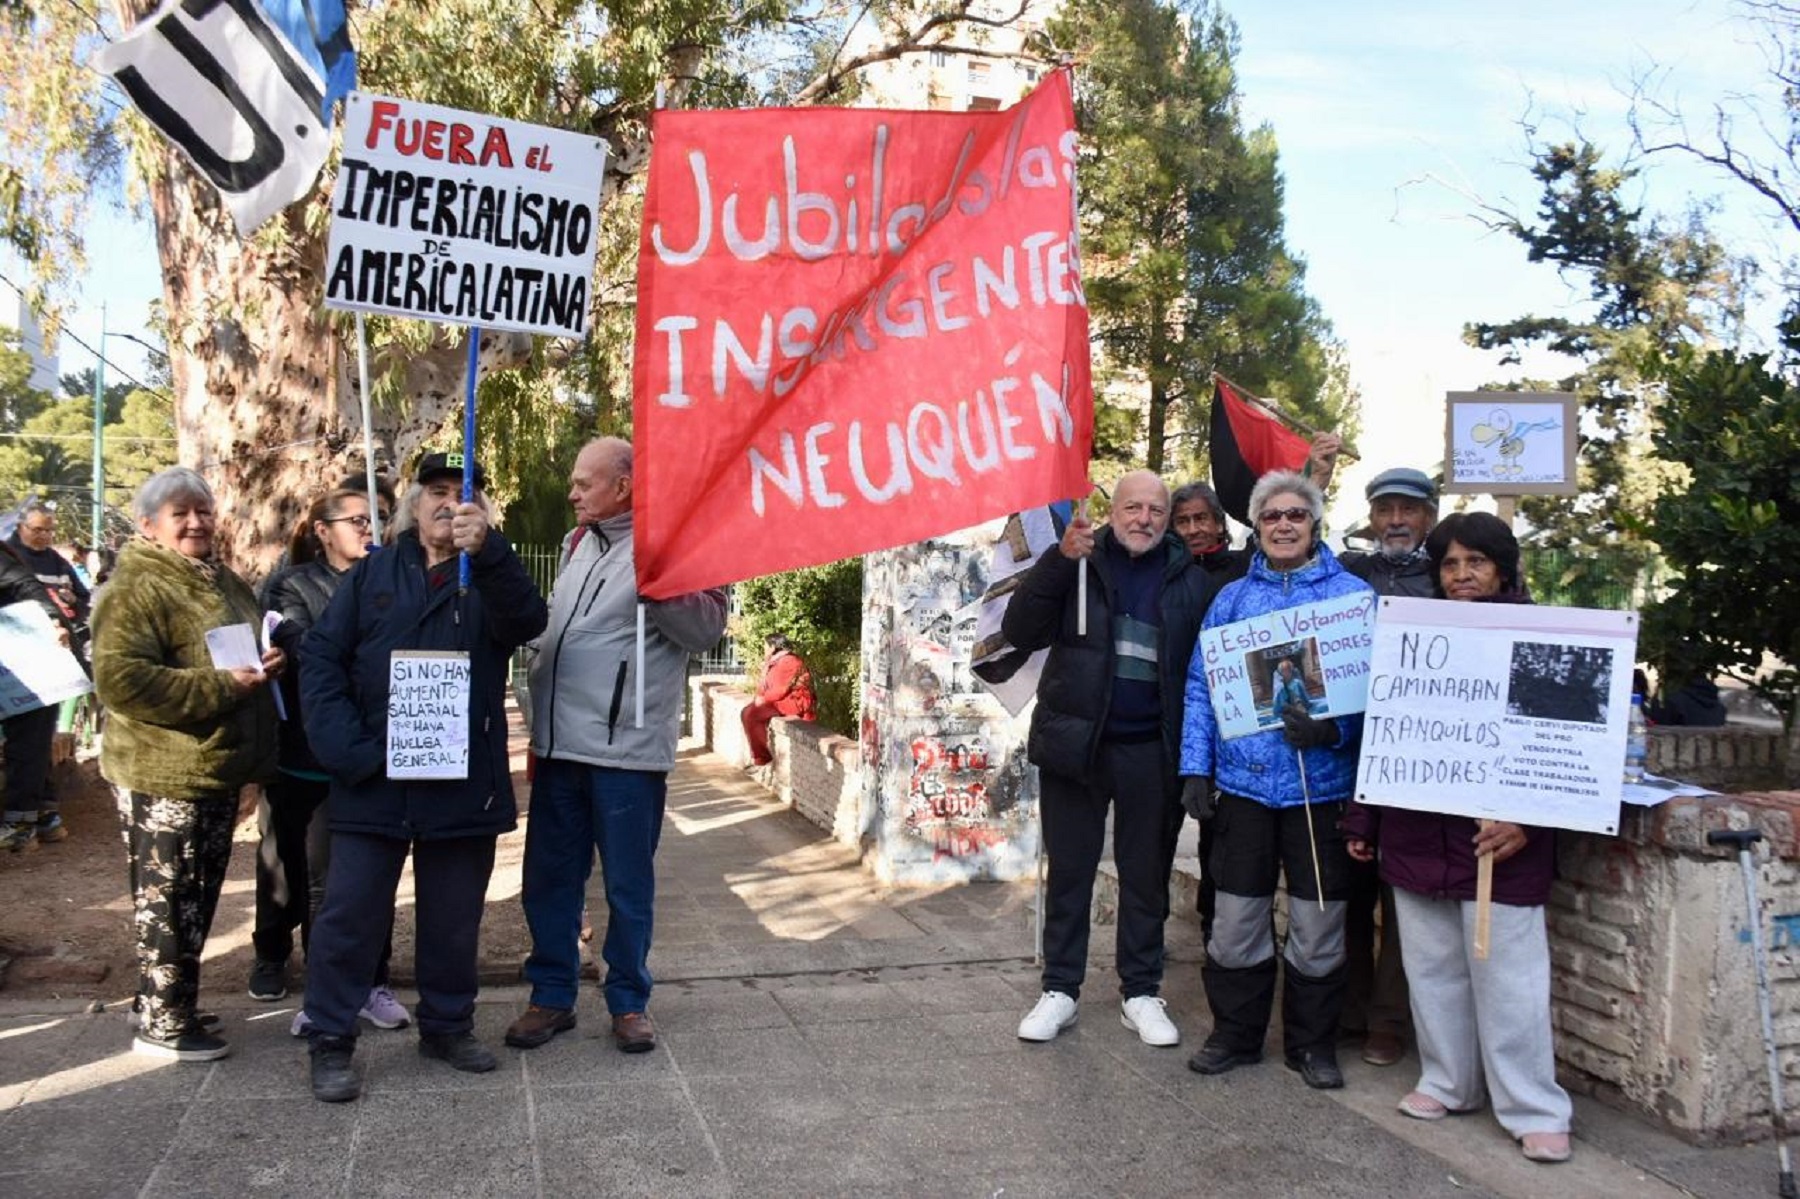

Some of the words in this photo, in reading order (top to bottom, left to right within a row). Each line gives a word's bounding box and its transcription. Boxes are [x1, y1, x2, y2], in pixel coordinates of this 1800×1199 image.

[365, 100, 514, 169] FUERA
[420, 239, 451, 257] DE
[749, 341, 1073, 517] NEUQUÉN
[1206, 624, 1272, 665] ¿Esto
[1281, 596, 1374, 639] Votamos?
[1320, 633, 1372, 657] DORES
[1400, 631, 1451, 671] NO
[418, 661, 443, 680] NO
[444, 661, 471, 682] HAY
[389, 682, 460, 702] AUMENTO
[1223, 689, 1234, 703] A
[1371, 673, 1501, 703] CAMINARAN
[1223, 704, 1243, 721] LA
[413, 720, 446, 734] HAYA
[1502, 717, 1532, 726] PABLO
[1533, 720, 1561, 729] CERVI
[1562, 723, 1608, 734] DIPUTADO
[391, 736, 443, 751] HUELGA
[1535, 732, 1551, 740] DEL
[1554, 734, 1573, 742] PRO
[1522, 744, 1583, 757] VENDEPATRIA
[1513, 757, 1538, 766] VOTO
[1539, 759, 1576, 770] CONTRA
[1502, 766, 1531, 777] CLASE
[1533, 770, 1599, 784] TRABAJADORA
